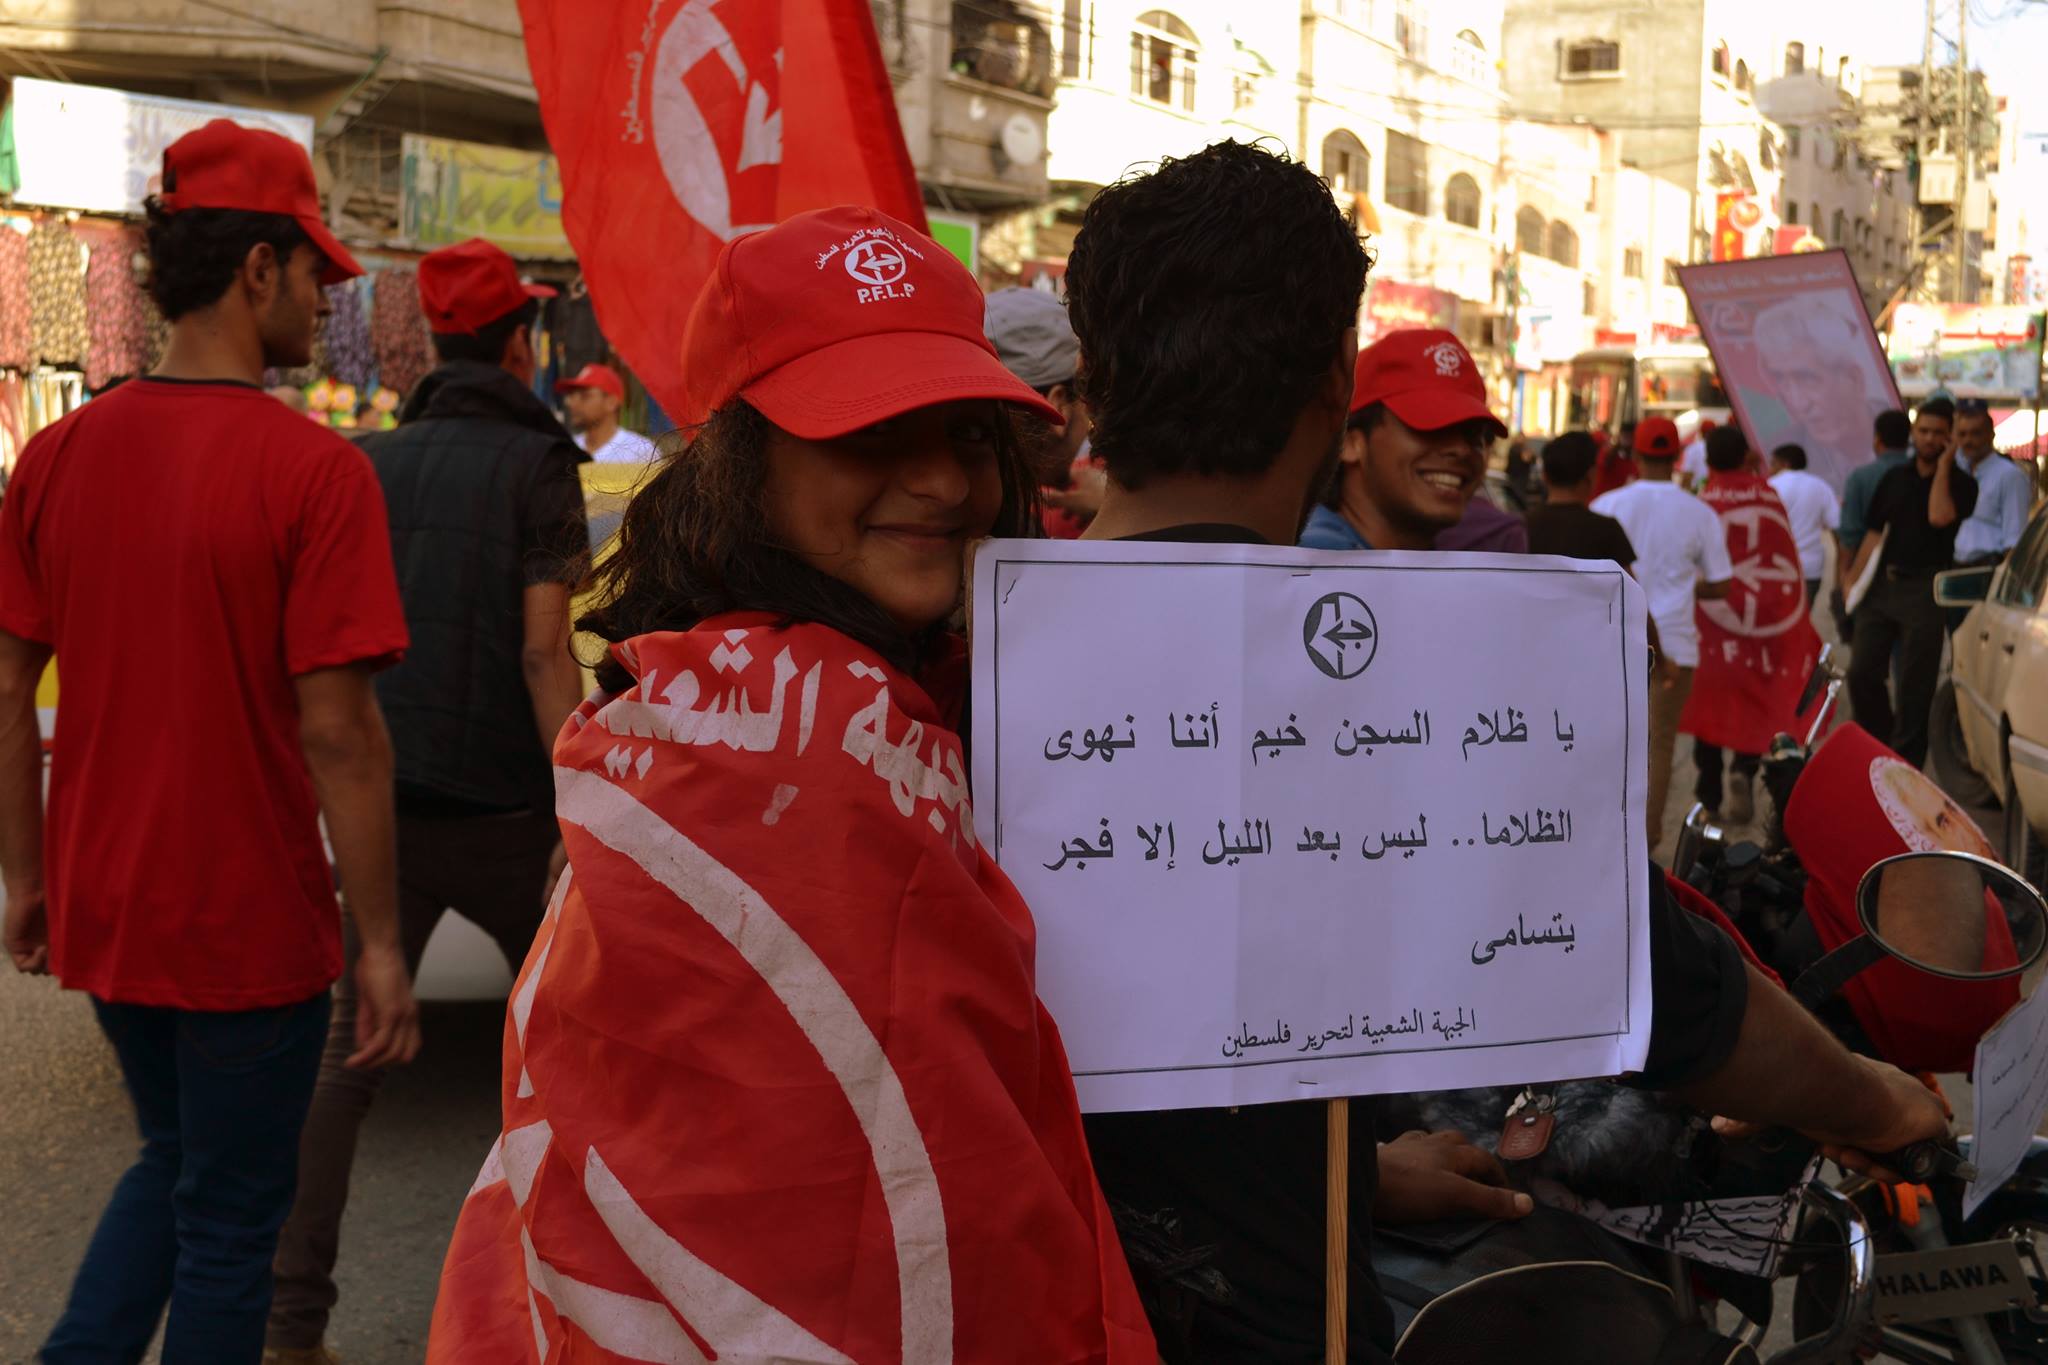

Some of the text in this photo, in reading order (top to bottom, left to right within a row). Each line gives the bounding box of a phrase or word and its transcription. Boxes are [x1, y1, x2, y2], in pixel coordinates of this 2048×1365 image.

[857, 283, 915, 304] P.F.L.P
[595, 629, 822, 781] الشعبي
[1043, 701, 1575, 767] يا ظلام السجن خيم أننا نهوى
[1042, 817, 1115, 872] فجر
[1136, 820, 1176, 872] إلا
[1201, 817, 1272, 867] الليل
[1297, 825, 1341, 863] بعد
[1361, 812, 1428, 861] ليس
[1470, 911, 1576, 966] يتسامى
[1221, 1006, 1476, 1059] الجبهة الشعبية لتحرير فلسطين
[1876, 1263, 2008, 1297] HALAWA
